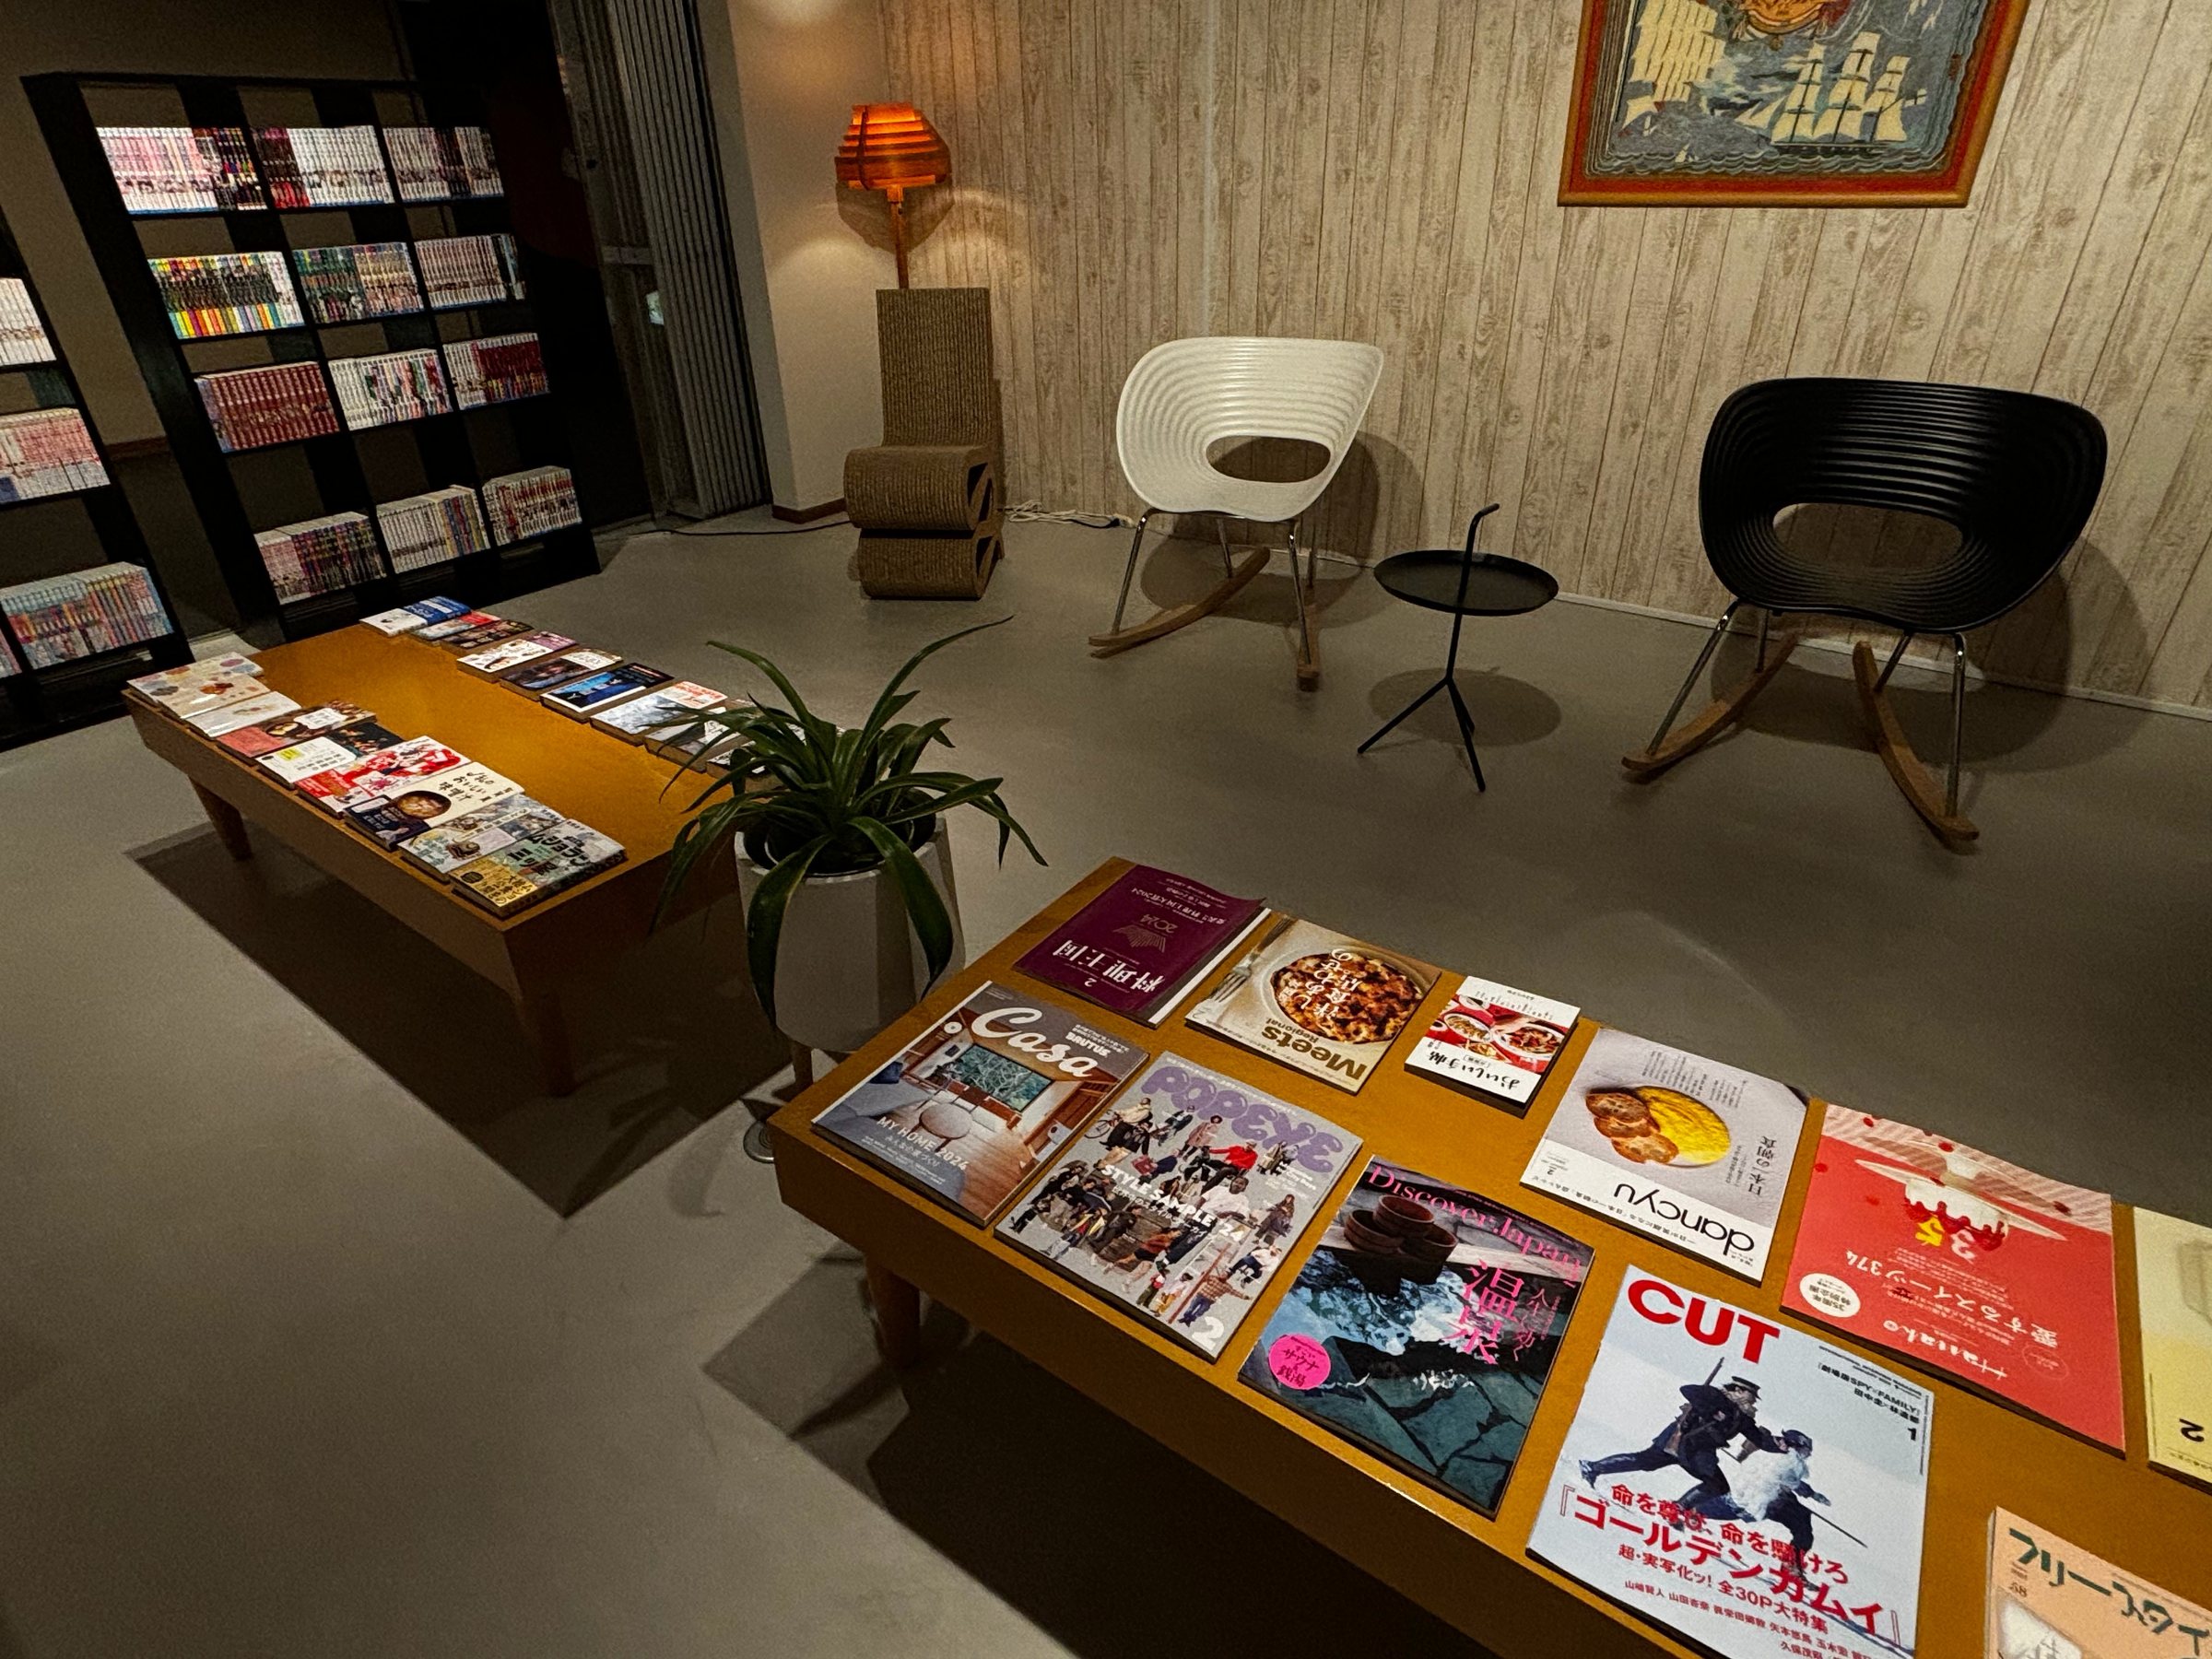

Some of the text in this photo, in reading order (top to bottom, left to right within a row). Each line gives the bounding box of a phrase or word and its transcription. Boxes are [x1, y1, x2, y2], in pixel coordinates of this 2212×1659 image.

[1137, 912, 1180, 934] 2024
[1050, 938, 1167, 995] 料理王国
[1081, 976, 1099, 987] 2
[1295, 947, 1353, 1012] しあわせの
[972, 1007, 1097, 1077] Casa
[1062, 1030, 1112, 1058] BRUTUS
[1258, 1024, 1368, 1080] Meets
[1265, 1017, 1319, 1043] Regional
[1425, 1050, 1521, 1091] おいしい手帖
[876, 1115, 900, 1133] MY
[895, 1125, 936, 1152] HOME
[933, 1146, 971, 1171] 2024
[1142, 1065, 1344, 1172] POPEYE
[1747, 1135, 1779, 1197] 日本一の朝食
[1100, 1163, 1154, 1195] STYLE
[1151, 1188, 1217, 1228] SAMPLE
[1365, 1163, 1494, 1230] Discover
[1491, 1216, 1583, 1270] Japan
[1613, 1181, 1754, 1254] dancyu
[1439, 1257, 1530, 1369] 温泉
[1627, 1277, 1780, 1364] CUT
[1808, 1282, 1851, 1307] 特別企画
[1811, 1291, 1846, 1312] 35周年
[1188, 1312, 1230, 1351] 2
[1506, 1284, 1552, 1366] 人生に効く
[1882, 1316, 2007, 1383] Hanako
[1279, 1346, 1321, 1375] サウナ
[1906, 1425, 1918, 1442] 1
[2178, 1418, 2206, 1443] 2
[1553, 1484, 1904, 1650] 『ゴールデンカムイ』
[1716, 1577, 1830, 1634] 全30P大特集
